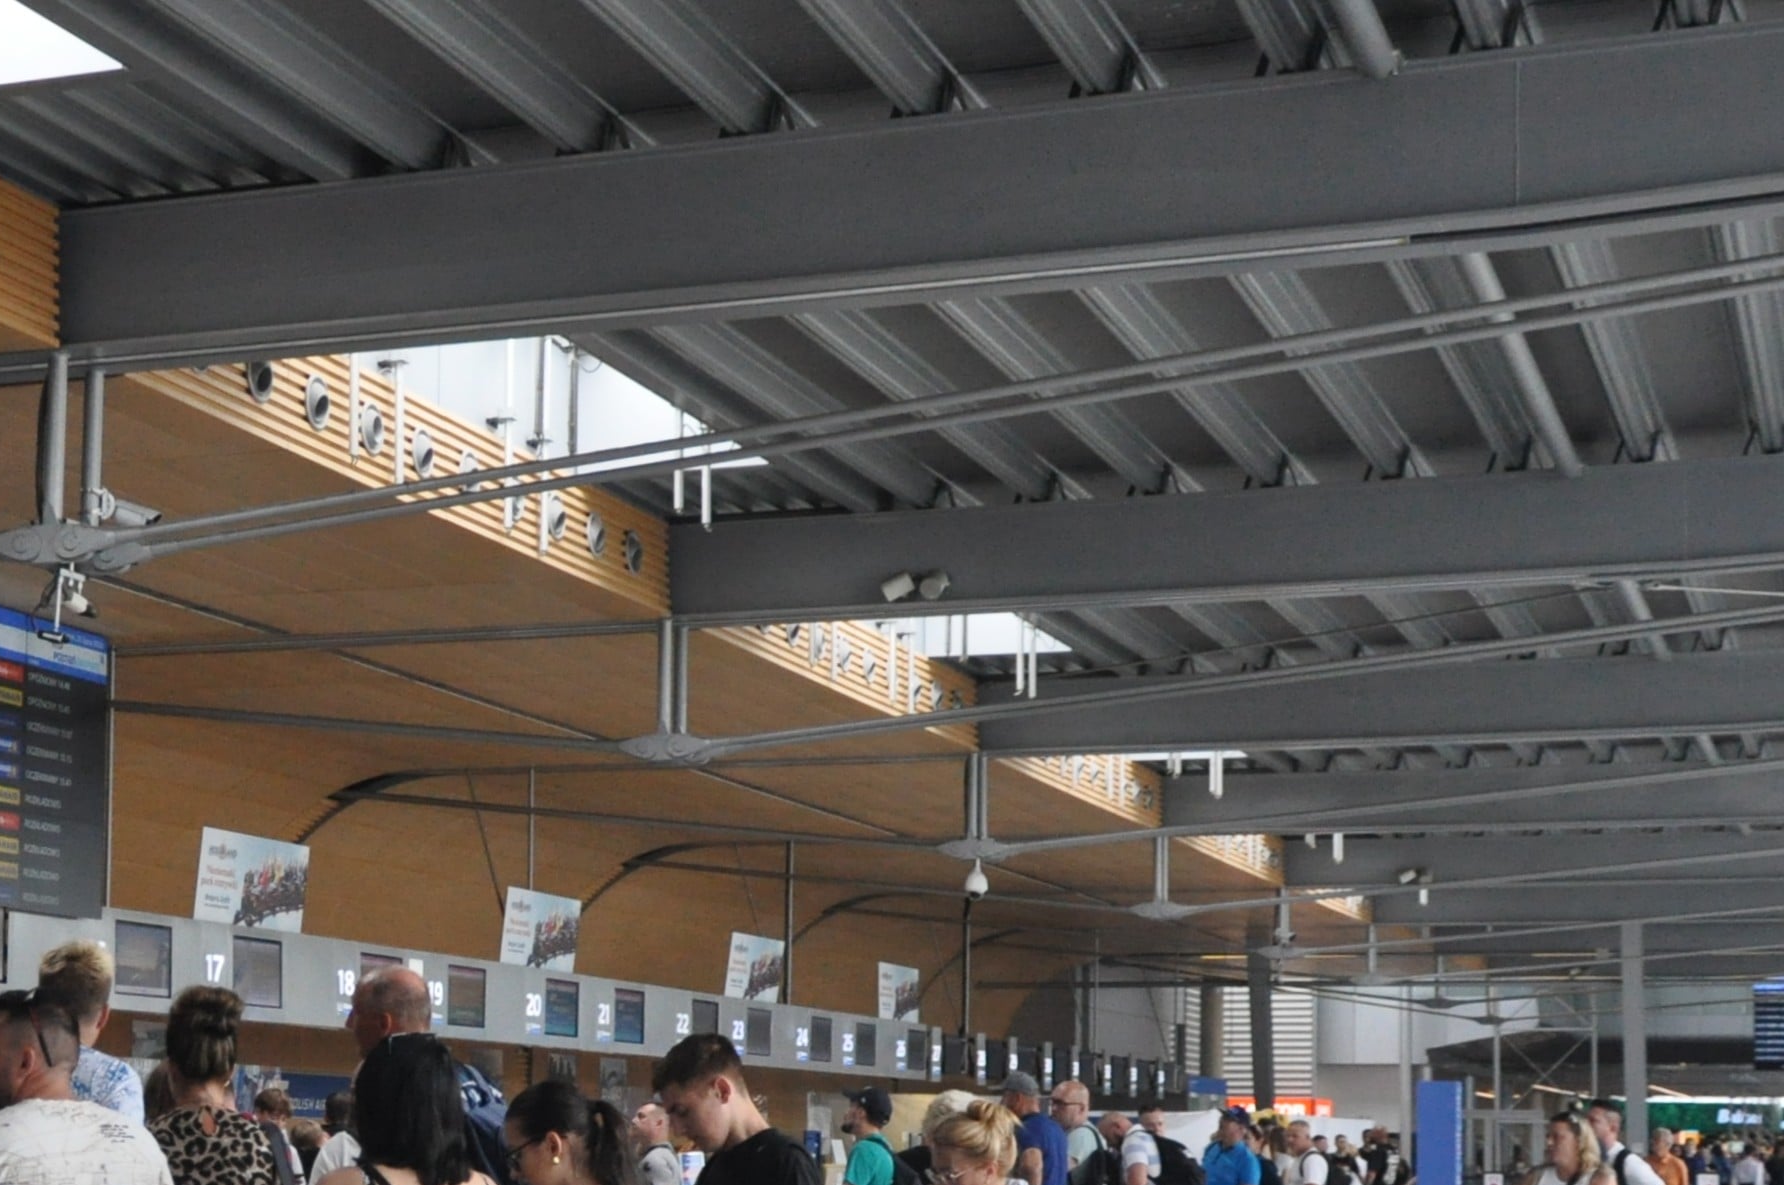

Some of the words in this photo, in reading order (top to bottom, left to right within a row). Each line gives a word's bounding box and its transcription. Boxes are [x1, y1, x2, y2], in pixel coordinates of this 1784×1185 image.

[205, 954, 225, 982] 17
[337, 969, 355, 996] 18
[526, 993, 542, 1017] 20
[598, 1003, 610, 1025] 21
[676, 1013, 689, 1034] 22
[732, 1020, 745, 1040] 23
[796, 1028, 809, 1047] 24
